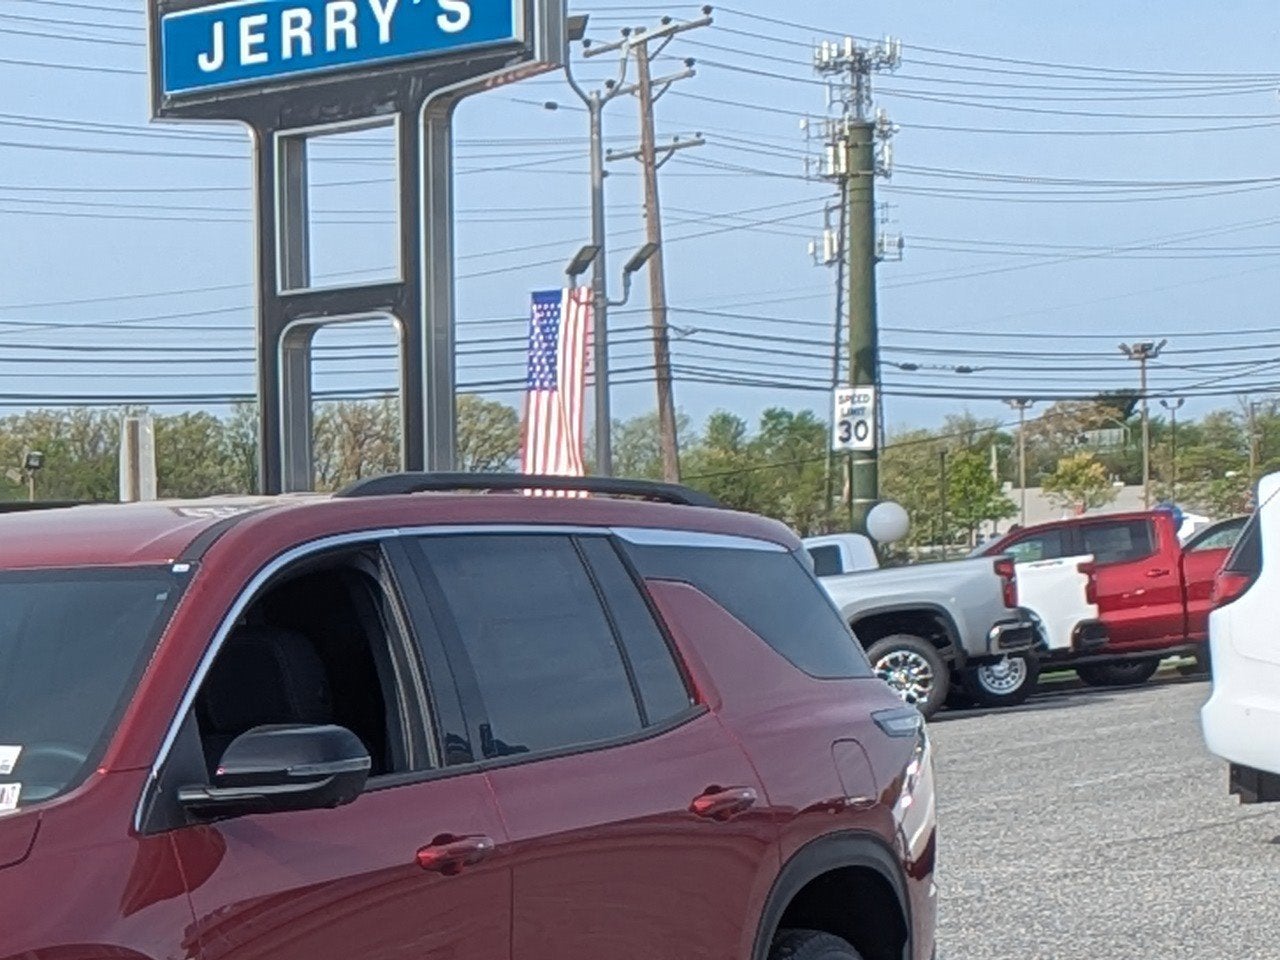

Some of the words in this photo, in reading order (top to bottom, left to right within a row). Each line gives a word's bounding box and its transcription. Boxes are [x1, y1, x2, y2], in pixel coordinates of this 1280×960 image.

[197, 0, 472, 73] JERRYS
[839, 394, 870, 404] SPEED
[841, 407, 866, 417] LIMIT
[838, 419, 869, 443] 30
